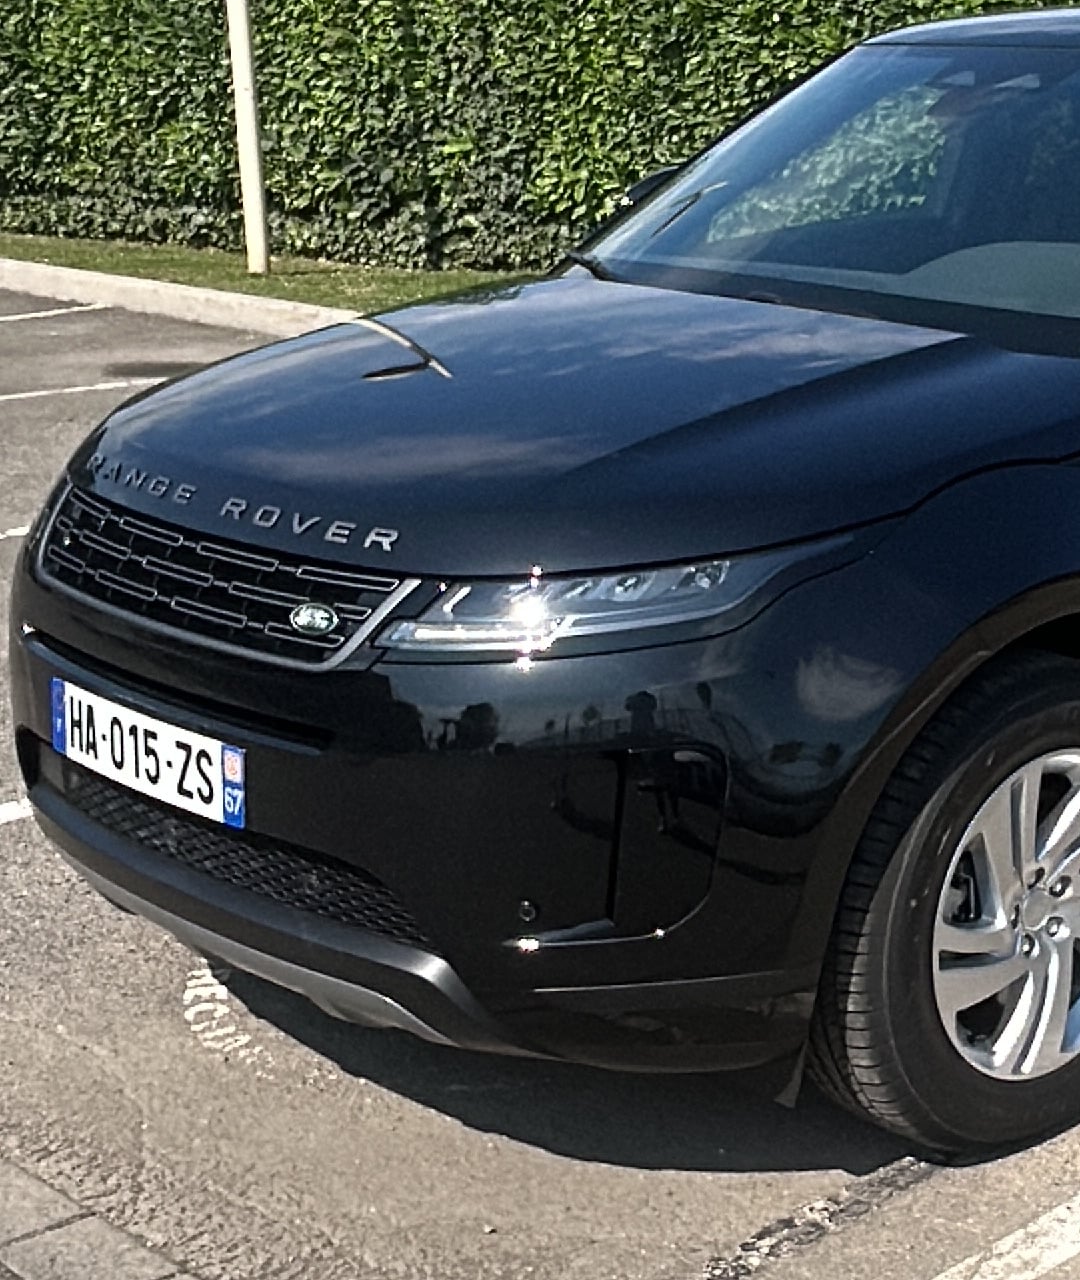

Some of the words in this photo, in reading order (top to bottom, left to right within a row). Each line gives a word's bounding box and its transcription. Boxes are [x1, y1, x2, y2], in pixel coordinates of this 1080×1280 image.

[86, 453, 198, 505] RANGE
[220, 497, 400, 553] ROVER
[69, 695, 215, 805] HA-015-ZS
